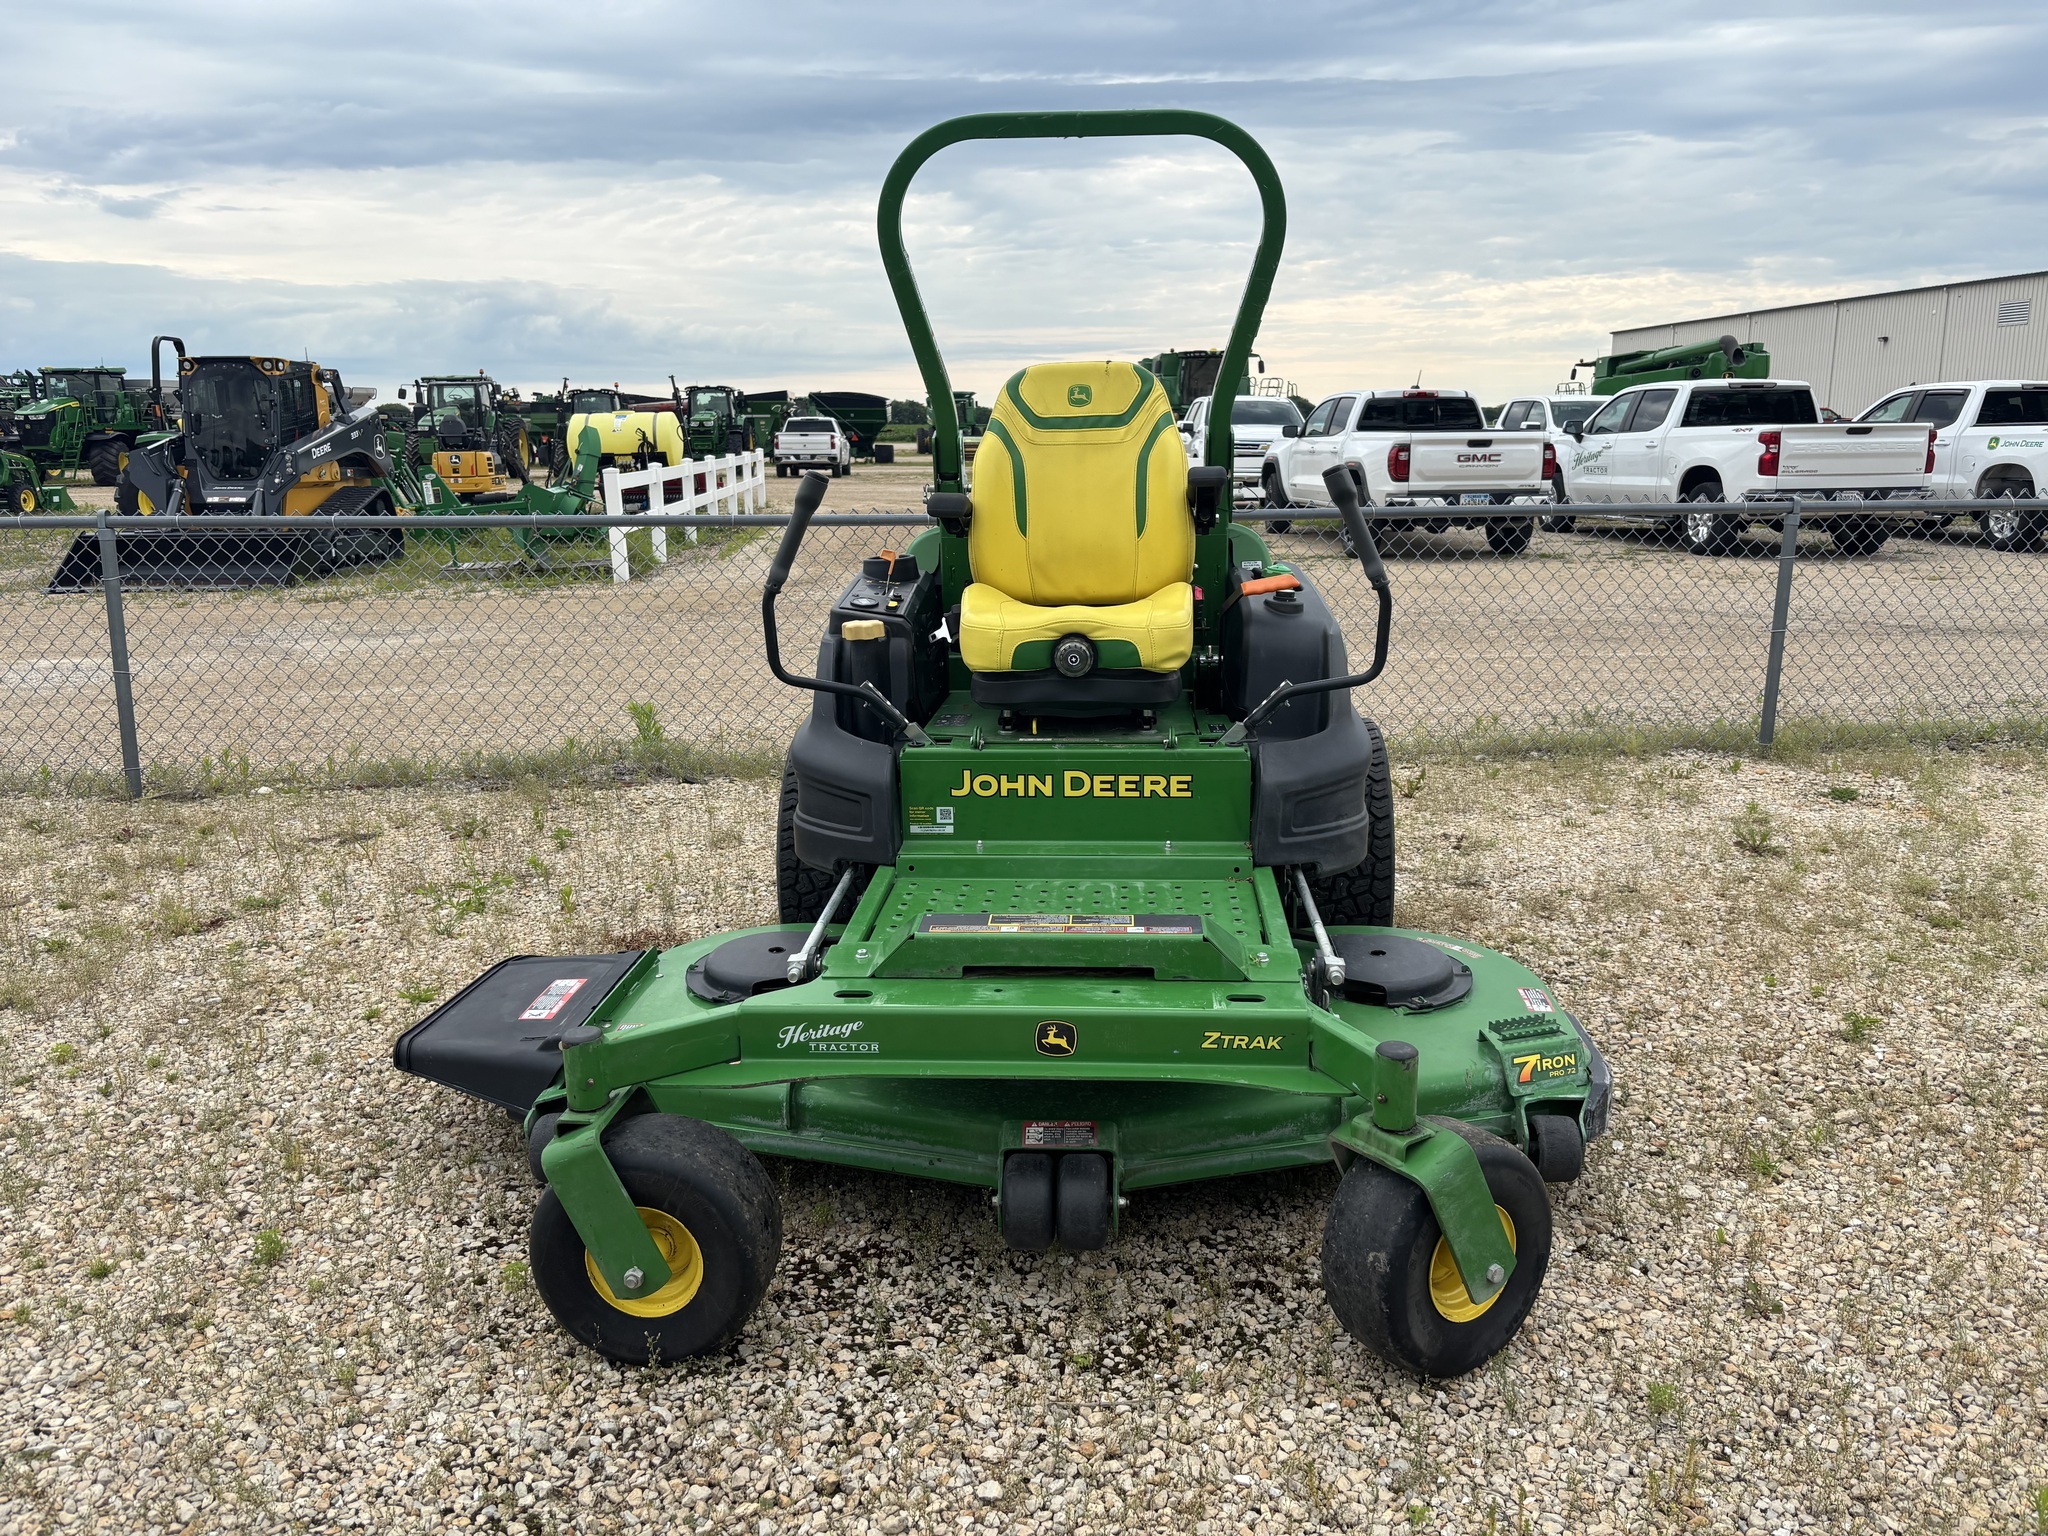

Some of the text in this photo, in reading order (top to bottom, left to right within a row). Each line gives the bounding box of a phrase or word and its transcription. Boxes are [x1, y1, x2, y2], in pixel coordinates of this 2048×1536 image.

[2000, 440, 2045, 448] JOHN DEERE
[311, 443, 332, 459] DEERE
[1457, 453, 1502, 463] GMC
[1572, 449, 1604, 470] Heritage
[1583, 466, 1608, 474] TRACTOR
[950, 769, 1193, 798] JOHN DEERE
[776, 1020, 864, 1049] Heritage
[1201, 1031, 1284, 1050] ZTRAK
[809, 1043, 880, 1052] TRACTOR
[1567, 1067, 1576, 1076] 72
